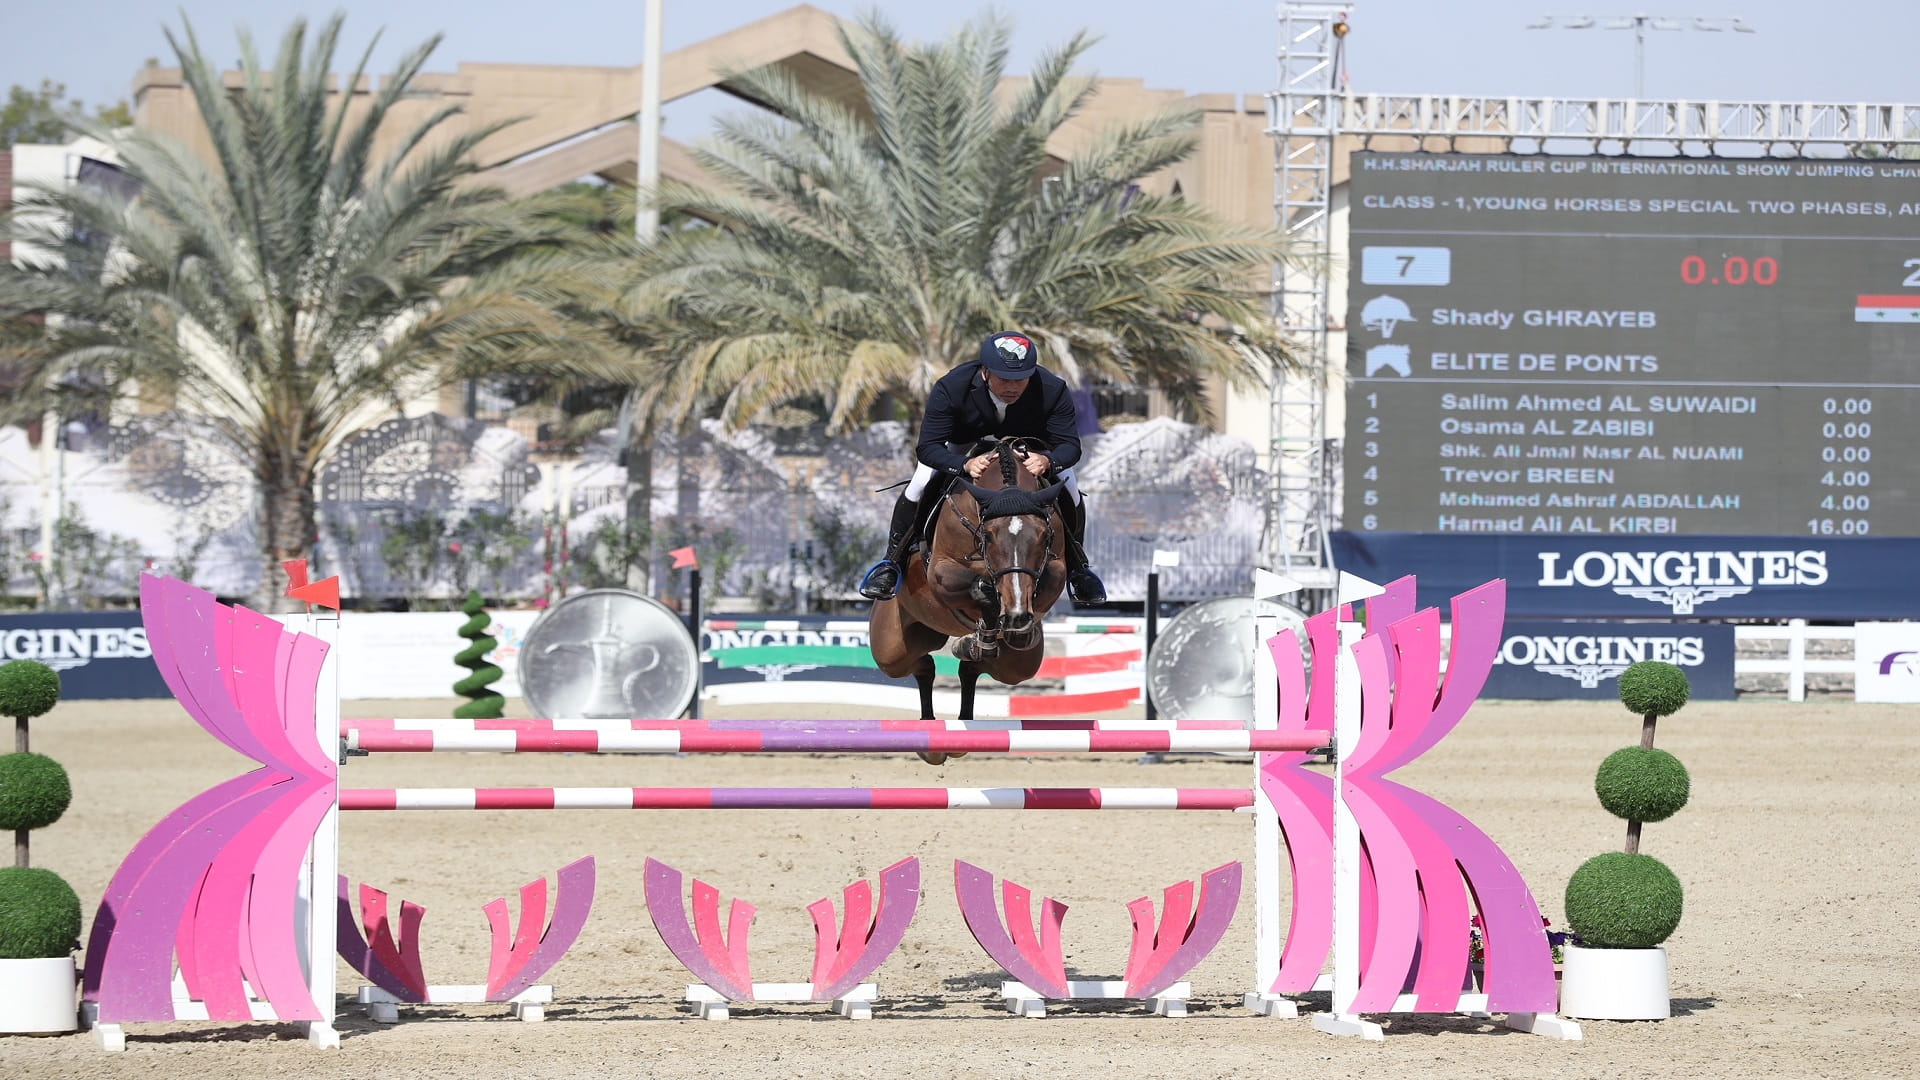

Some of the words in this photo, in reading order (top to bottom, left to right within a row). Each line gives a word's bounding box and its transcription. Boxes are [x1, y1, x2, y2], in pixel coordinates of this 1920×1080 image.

[1363, 158, 1482, 172] H.H.SHARJAH
[1485, 159, 1545, 173] RULER
[1549, 160, 1588, 174] CUP
[1591, 161, 1731, 176] INTERNATIONAL
[1736, 163, 1791, 177] SHOW
[1795, 165, 1875, 178] JUMPING
[1363, 195, 1435, 209] CLASS
[1554, 198, 1643, 212] HORSES
[1648, 199, 1740, 214] SPECIAL
[1747, 200, 1796, 214] TWO
[1801, 201, 1893, 218] PHASES,
[1395, 255, 1416, 278] 7
[1681, 255, 1779, 286] 0.00
[1431, 308, 1515, 330] Shady
[1522, 309, 1657, 329] GHRAYEB
[1430, 352, 1510, 371] ELITE
[1518, 353, 1557, 372] DE
[1565, 354, 1659, 373] PONTS
[1366, 392, 1378, 409] 1
[1441, 393, 1509, 411] Salim
[1515, 394, 1602, 412] Ahmed
[1608, 395, 1642, 413] AL
[1648, 395, 1757, 414] SUWAIDI
[1823, 397, 1873, 415] 0.00
[1364, 416, 1380, 434] 2
[1440, 417, 1526, 435] Osama
[1531, 418, 1566, 436] AL
[1571, 418, 1655, 437] ZABIBI
[1822, 421, 1872, 439] 0.00
[1364, 441, 1379, 458] 3
[1439, 443, 1486, 458] Shk.
[1492, 444, 1521, 458] Ali
[1582, 445, 1633, 460] Nasr
[1637, 445, 1665, 460] AL
[1672, 446, 1744, 461] NUAMI
[1821, 446, 1871, 463] 0.00
[1363, 465, 1378, 481] 4
[1439, 466, 1521, 483] Trevor
[1526, 467, 1615, 484] BREEN
[1820, 470, 1871, 487] 4.00
[1364, 489, 1379, 506] 5
[1439, 491, 1541, 507] Mohamed
[1545, 492, 1618, 508] Ashraf
[1620, 493, 1740, 509] ABDALLAH
[1820, 494, 1870, 511] 4.00
[1362, 514, 1378, 531] 6
[1438, 514, 1524, 533] Hamad
[1530, 515, 1563, 533] Ali
[1568, 516, 1602, 533] AL
[1608, 516, 1677, 534] KIRBI
[1807, 518, 1870, 536] 16.00
[1538, 550, 1828, 587] LONGINES
[0, 627, 152, 659] GINES
[1493, 635, 1705, 666] ONGINES
